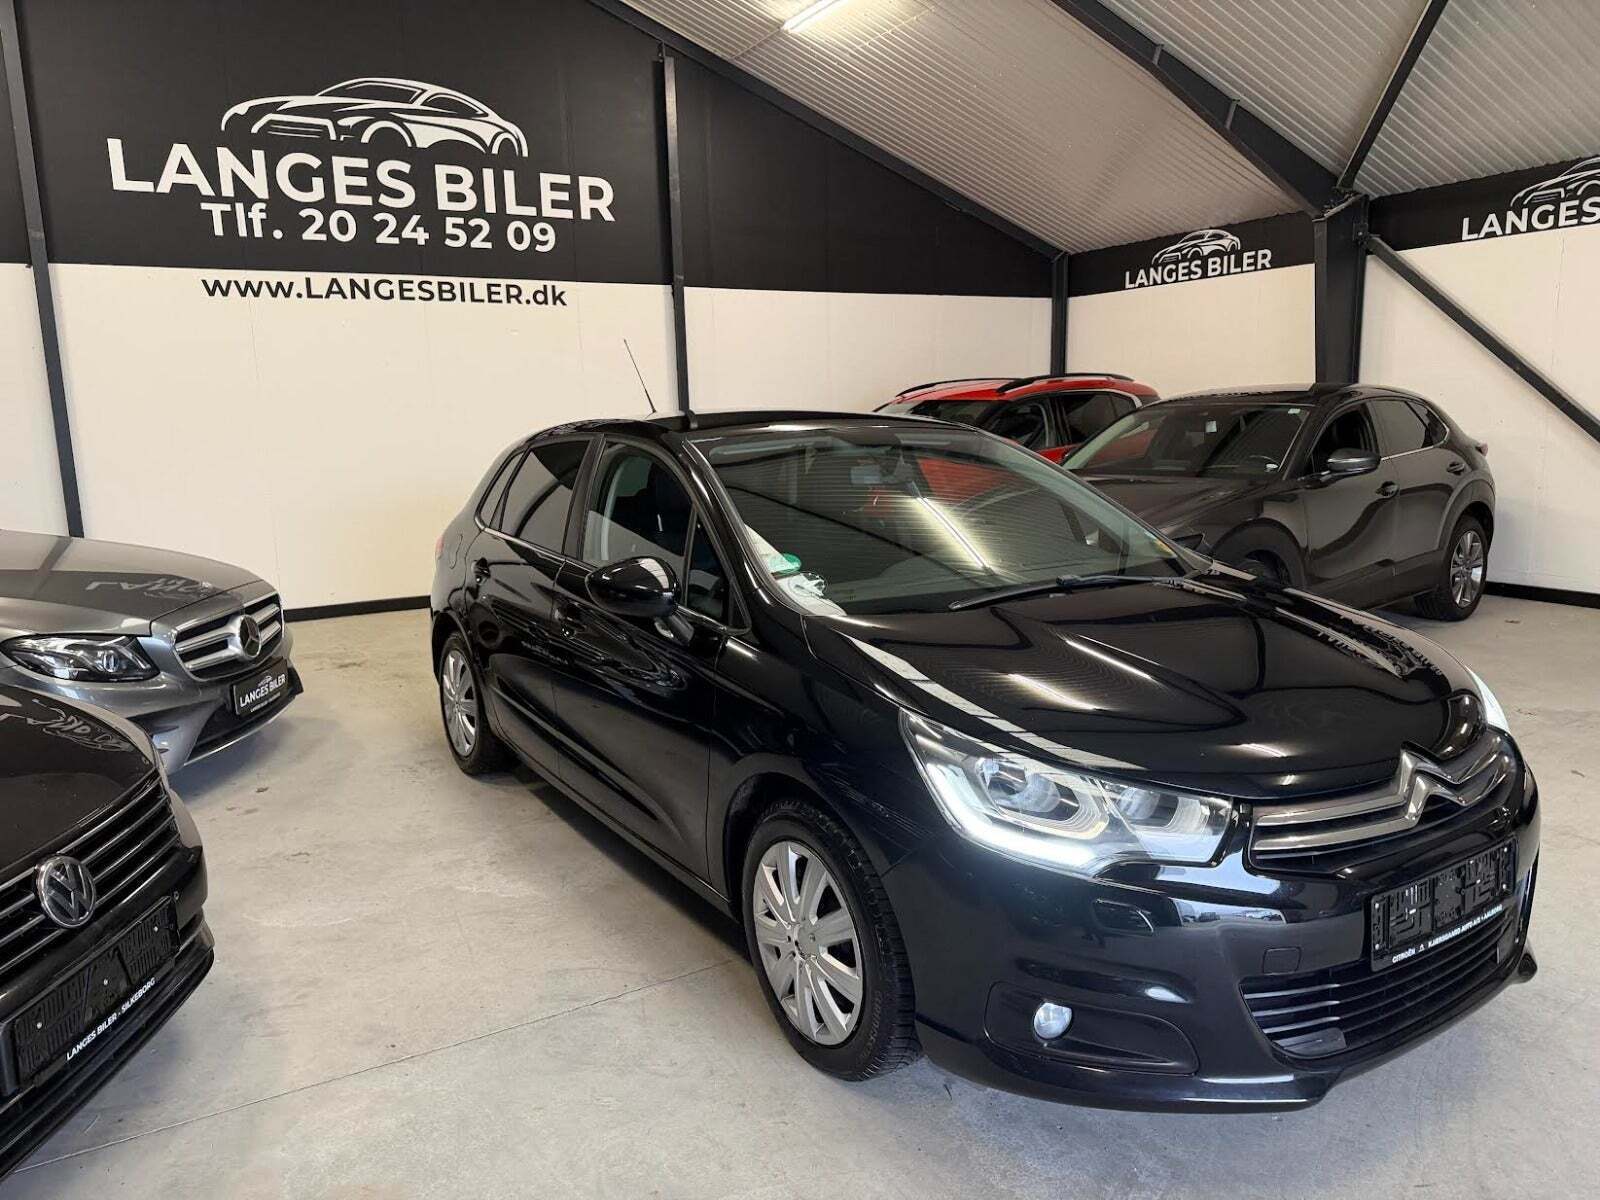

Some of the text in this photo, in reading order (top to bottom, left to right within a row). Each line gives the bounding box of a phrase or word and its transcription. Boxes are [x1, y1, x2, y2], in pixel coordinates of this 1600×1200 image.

[106, 138, 616, 222] LANGES BILER
[200, 202, 556, 253] Tlf. 20 24 52 09
[1460, 196, 1600, 241] LANGES
[201, 277, 567, 306] www.LANGESBILER.dk
[1125, 249, 1272, 289] LANGES BILER
[240, 683, 269, 707] LANGES
[269, 673, 286, 692] BILER
[66, 977, 156, 1061] LANGES BILER SILKEBORG
